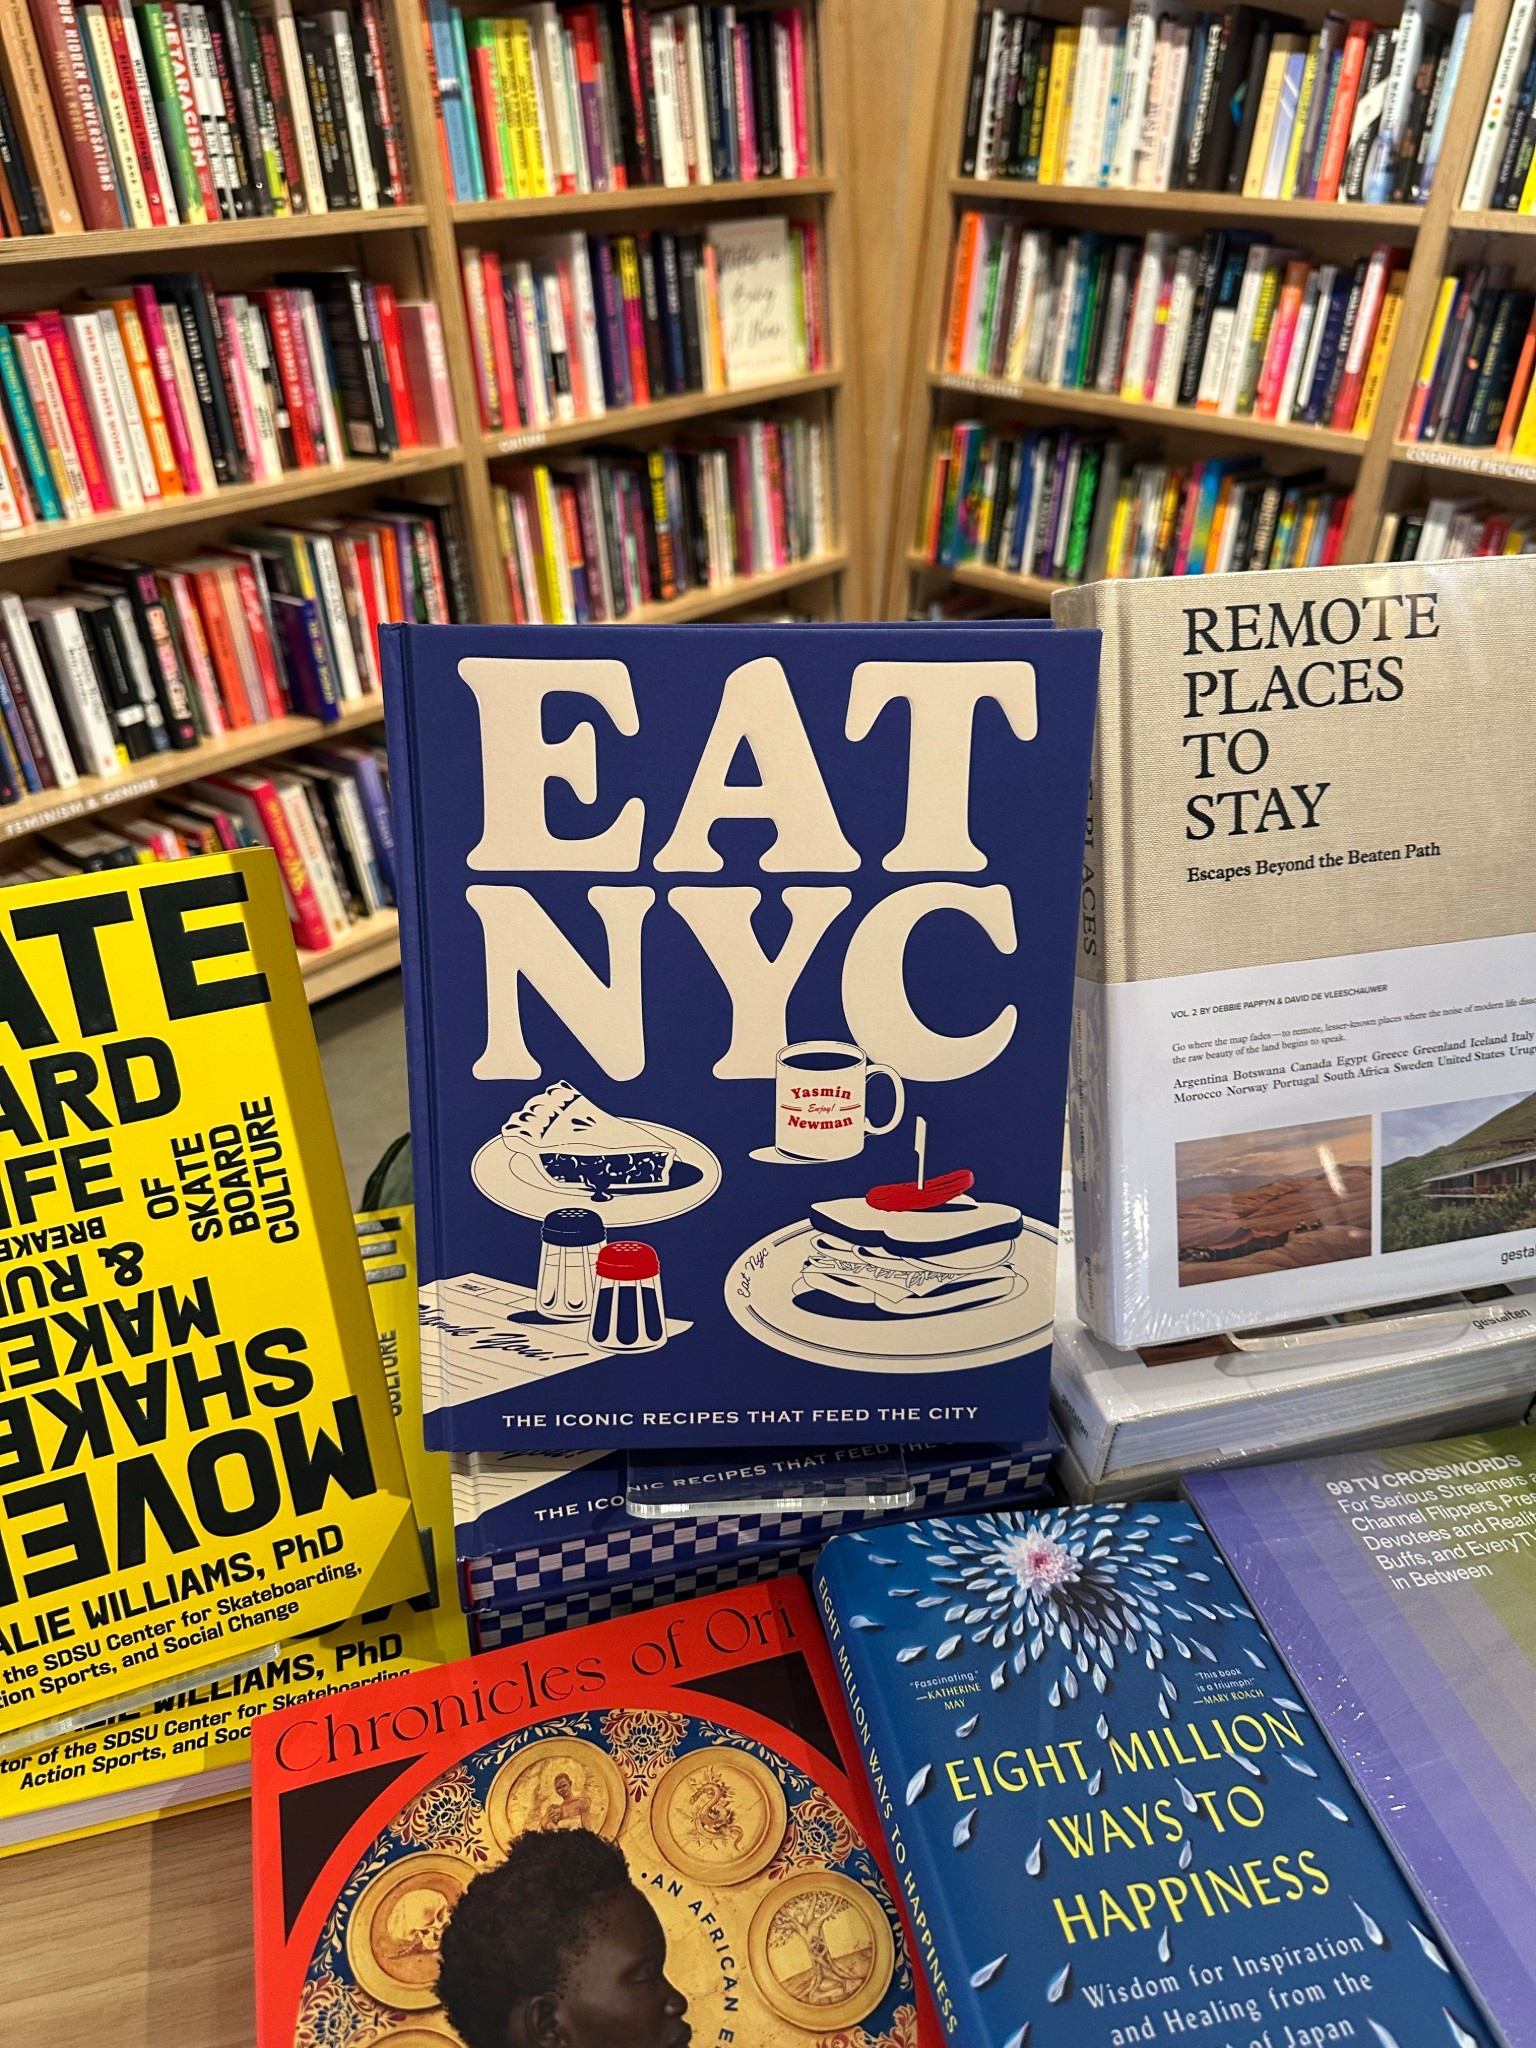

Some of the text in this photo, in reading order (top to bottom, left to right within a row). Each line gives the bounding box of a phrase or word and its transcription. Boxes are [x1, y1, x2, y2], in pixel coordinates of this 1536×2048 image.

[65, 30, 87, 79] HIDDEN
[77, 84, 115, 191] CONVERSATIONS
[163, 11, 207, 168] METARACISM
[1183, 593, 1440, 655] REMOTE
[1183, 656, 1404, 718] PLACES
[458, 656, 1038, 872] EAT
[1183, 728, 1269, 779] TO
[5, 802, 84, 835] FEMINISM
[1185, 782, 1330, 840] STAY
[1186, 841, 1441, 883] Escapes Beyond the Beaten Path
[466, 881, 1018, 1082] NYC
[1192, 1008, 1198, 1016] 2
[1200, 1007, 1210, 1015] BY
[1212, 1003, 1242, 1013] DEBBIE
[1243, 999, 1276, 1010] PAPPYN
[1277, 997, 1283, 1005] &
[1284, 994, 1310, 1004] DAVID
[1311, 992, 1322, 1000] DE
[1325, 984, 1388, 999] VLEESCHAUWER
[1172, 1043, 1185, 1052] Go
[1188, 1041, 1212, 1050] where
[1214, 1038, 1228, 1046] the
[1229, 1036, 1248, 1046] map
[1378, 1015, 1402, 1027] places
[1403, 1011, 1427, 1021] where
[1428, 1009, 1441, 1018] the
[1442, 1007, 1463, 1016] noise
[1464, 1004, 1473, 1013] of
[1474, 1001, 1503, 1011] modern
[1172, 1034, 1346, 1064] the raw beauty of the land begins to speak.
[1173, 1030, 1535, 1091] Argentina Botswana Canada Egypt Greece Greenland Iceland Italy
[1174, 1048, 1505, 1104] Morocco Norway Portugal South Africa Sweden United States
[791, 1085, 852, 1101] Yasmin
[807, 1102, 836, 1114] Enjoy!
[787, 1113, 853, 1131] Newman
[170, 1132, 223, 1242] SKATE
[208, 1124, 261, 1236] BOARD
[239, 1096, 300, 1245] CULTURE
[141, 1176, 180, 1219] OF
[97, 1241, 144, 1286] &
[736, 1271, 752, 1299] Eat
[0, 1276, 221, 1392] MAKE
[1472, 1308, 1532, 1330] gestalten
[502, 1406, 979, 1428] THE ICONIC RECIPES THAT FEED THE CITY
[0, 1395, 377, 1605] MOVE
[1326, 1480, 1353, 1496] 99
[1351, 1475, 1380, 1491] TV
[1381, 1454, 1522, 1488] CROSSWORDS
[1337, 1499, 1370, 1513] For
[1370, 1490, 1438, 1509] Serious
[1437, 1473, 1528, 1499] Streamers
[1351, 1498, 1504, 1531] Channel Flippers,
[1362, 1519, 1489, 1550] Devotees and
[81, 1523, 345, 1630] WILLIAMS, PhD
[1375, 1550, 1434, 1570] Buffs,
[1432, 1543, 1469, 1562] and
[1465, 1537, 1520, 1557] Every
[1389, 1564, 1494, 1590] in Between
[2, 1561, 363, 1685] the SDSU Center for Skateboarding,
[39, 1600, 300, 1694] Sports, and Social Change
[275, 1657, 607, 1773] Chronicles
[630, 1617, 687, 1678] of
[705, 1599, 798, 1655] Ori
[1196, 1683, 1205, 1692] is
[1219, 1666, 1242, 1677] book
[1232, 1688, 1264, 1701] ROACH
[944, 1698, 966, 1711] MAY
[944, 1708, 1306, 1803] EIGHT MILLION
[817, 1575, 959, 2034] EIGHT MILLION WAYS TO HAPPINESS
[1048, 1785, 1266, 1861] WAYS TO
[1052, 1849, 1331, 1945] HAPPINESS
[651, 1873, 683, 1898] AN
[688, 1900, 739, 2012] AFRICAN
[1081, 1934, 1365, 2008] Wisdom for Inspiration
[1111, 1970, 1374, 2047] and Healing from the
[1250, 2016, 1356, 2048] of Japan
